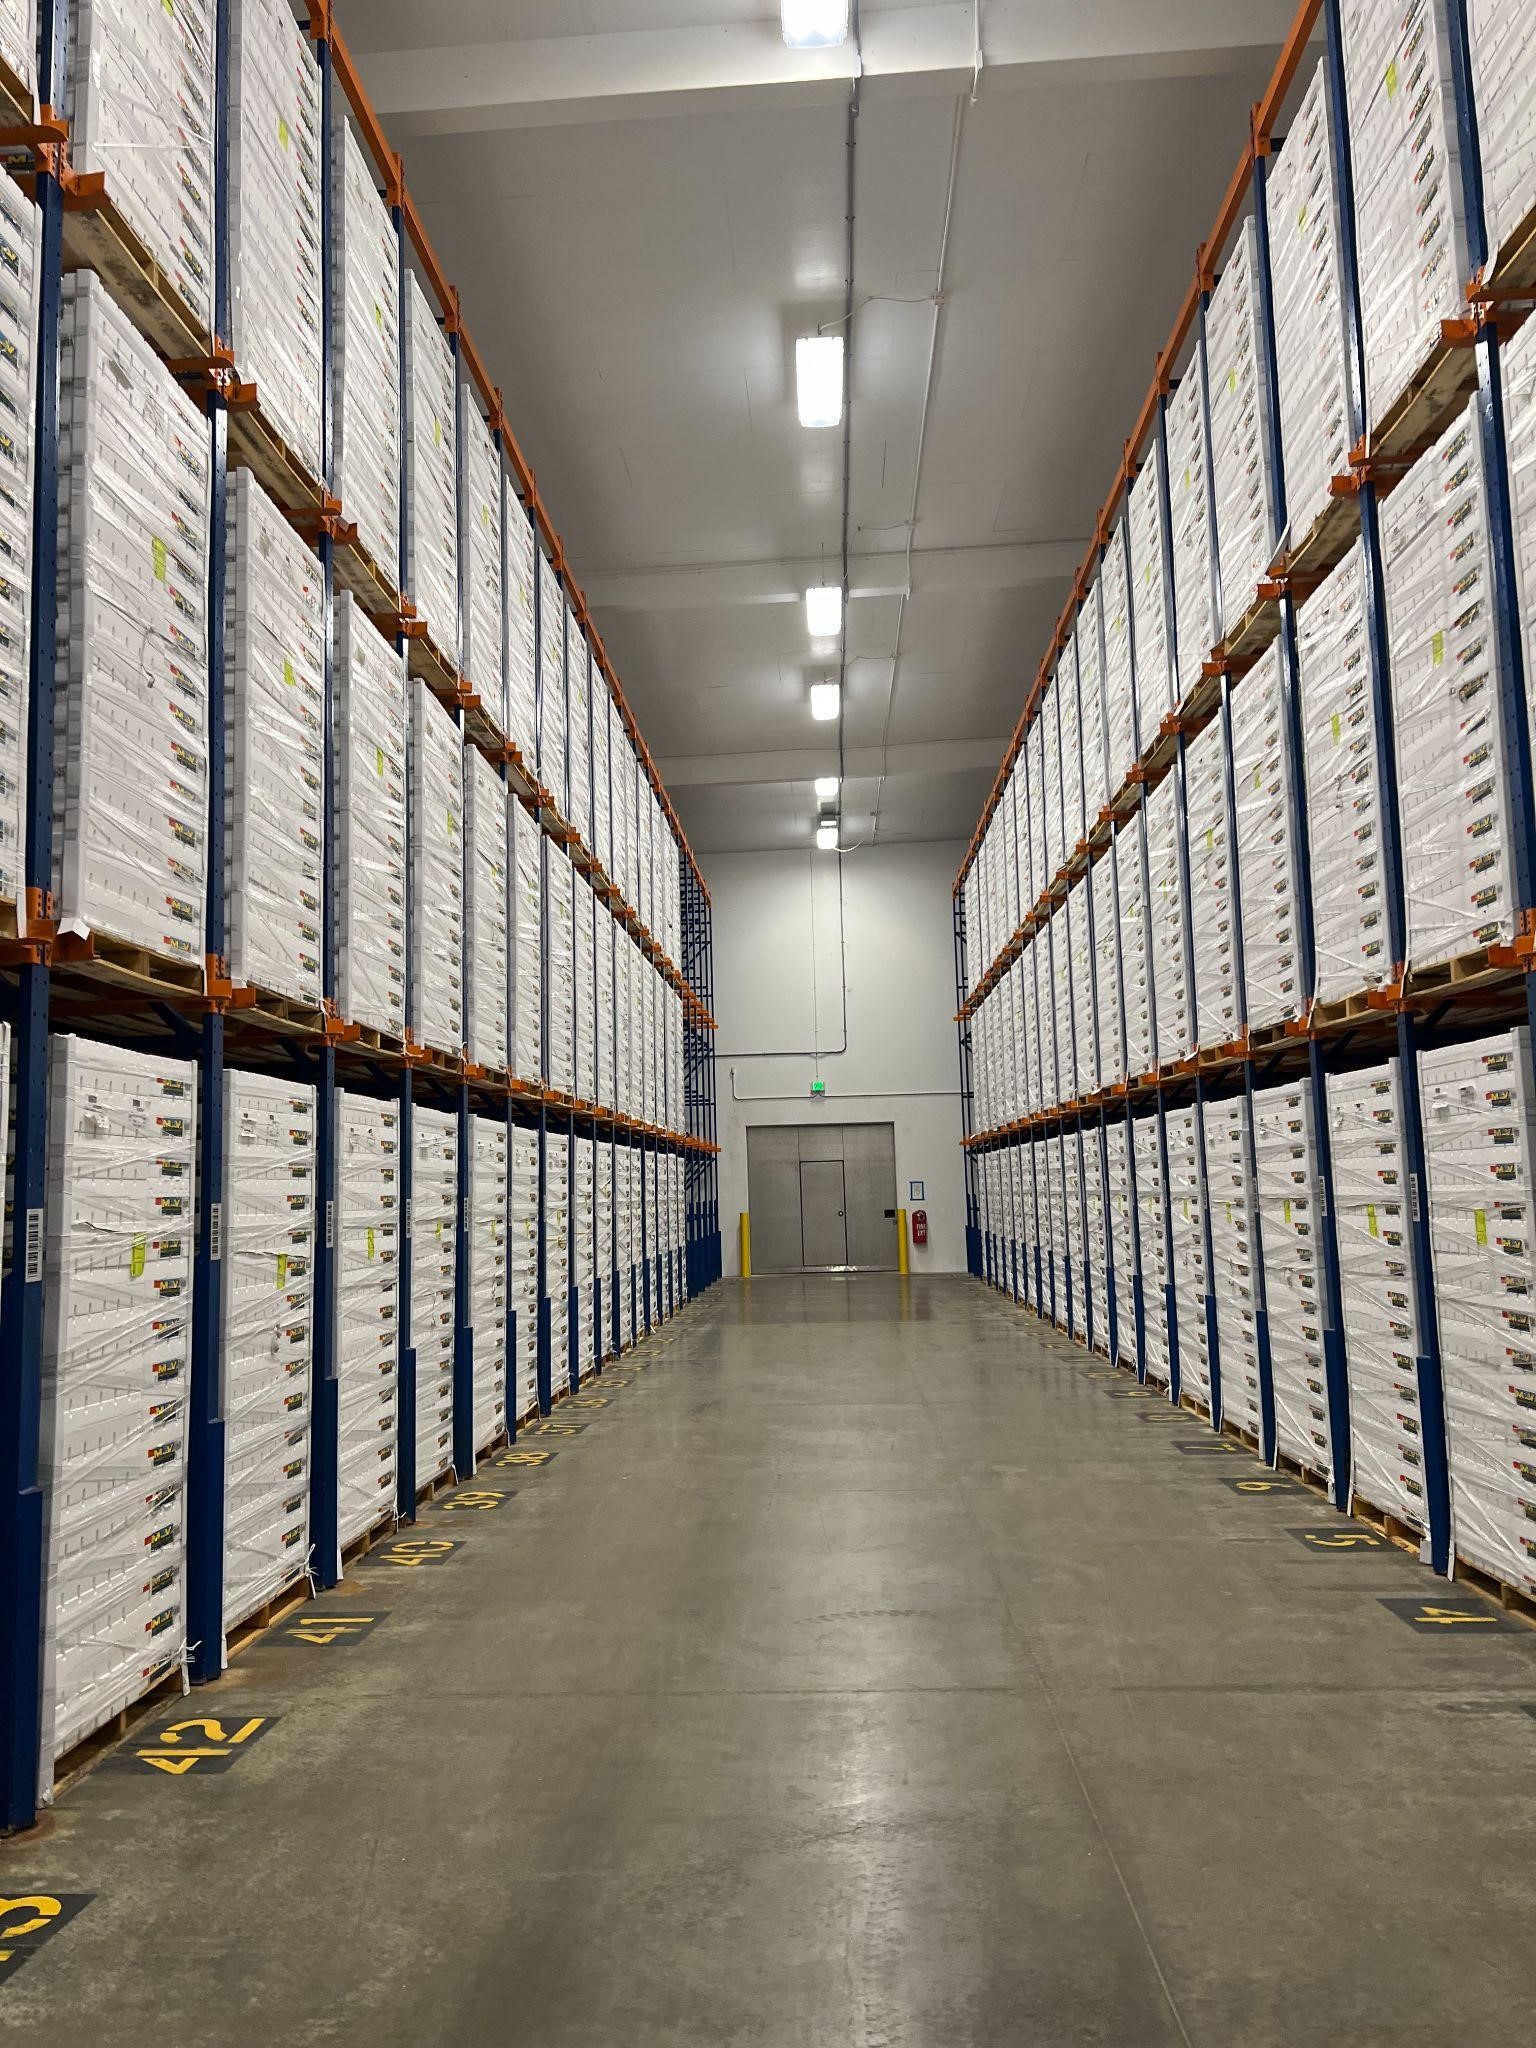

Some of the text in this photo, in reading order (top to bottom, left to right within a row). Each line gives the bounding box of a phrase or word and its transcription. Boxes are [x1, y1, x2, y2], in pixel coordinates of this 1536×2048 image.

[1147, 1414, 1190, 1422] 8
[1184, 1443, 1237, 1452] 7
[495, 1451, 550, 1467] 38
[1235, 1481, 1298, 1491] 6
[443, 1491, 506, 1511] 39
[1305, 1534, 1381, 1547] 5
[379, 1541, 455, 1567] 40
[1413, 1606, 1498, 1625] 4
[286, 1617, 375, 1644] 41
[136, 1718, 266, 1775] 42
